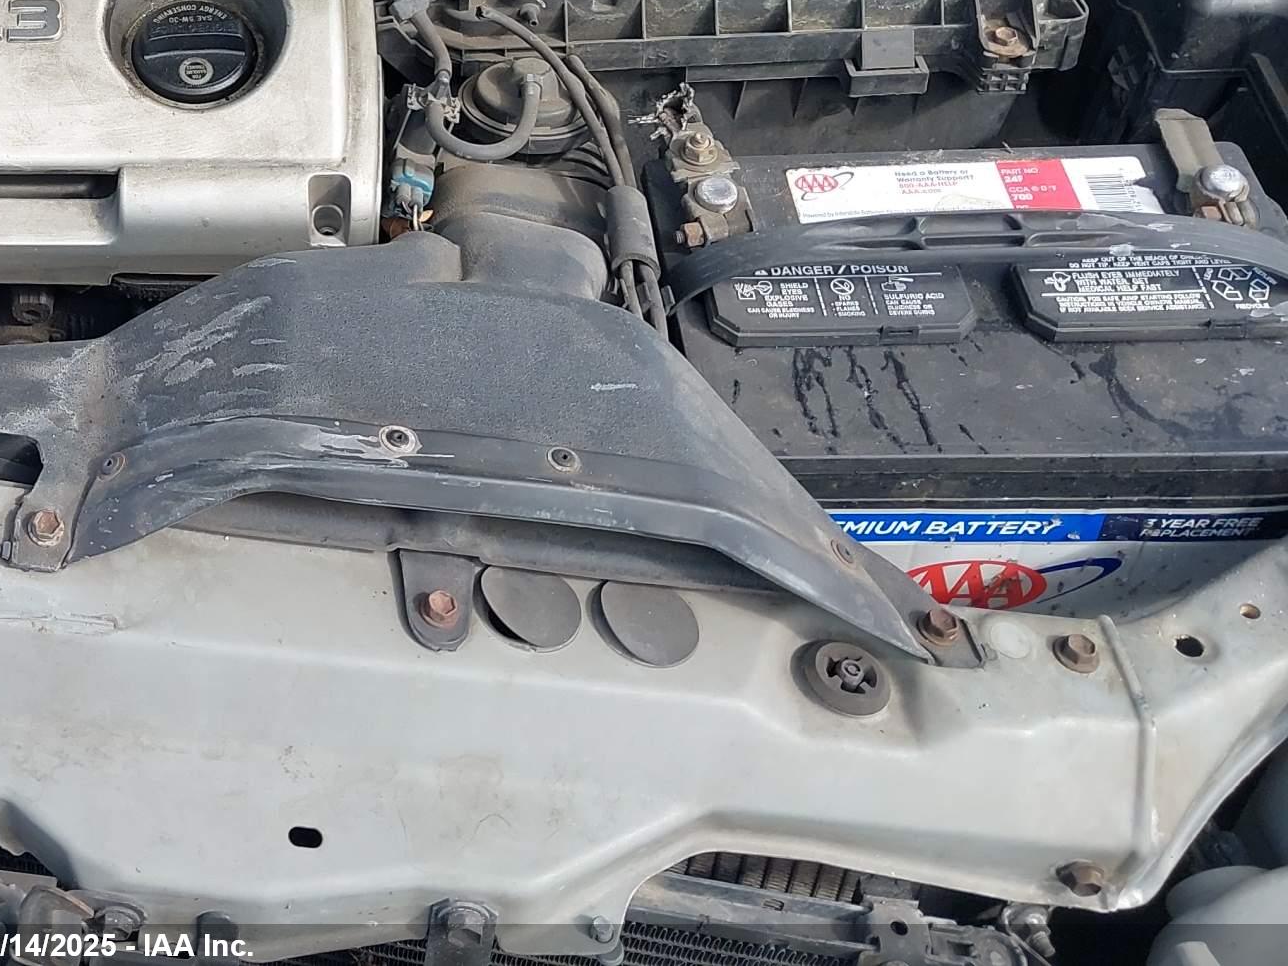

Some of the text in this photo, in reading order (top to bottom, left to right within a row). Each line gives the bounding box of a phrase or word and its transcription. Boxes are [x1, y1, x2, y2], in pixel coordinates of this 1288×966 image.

[153, 4, 228, 24] ENERGY CONSERVING
[197, 14, 212, 22] SAE
[795, 174, 838, 193] AAA
[770, 264, 909, 276] DANGER / POISON
[1124, 270, 1180, 278] IMMEDIATELY
[924, 520, 1064, 535] BATTERY
[1144, 517, 1264, 528] 3 YEAR FREE
[910, 561, 1038, 610] AAA
